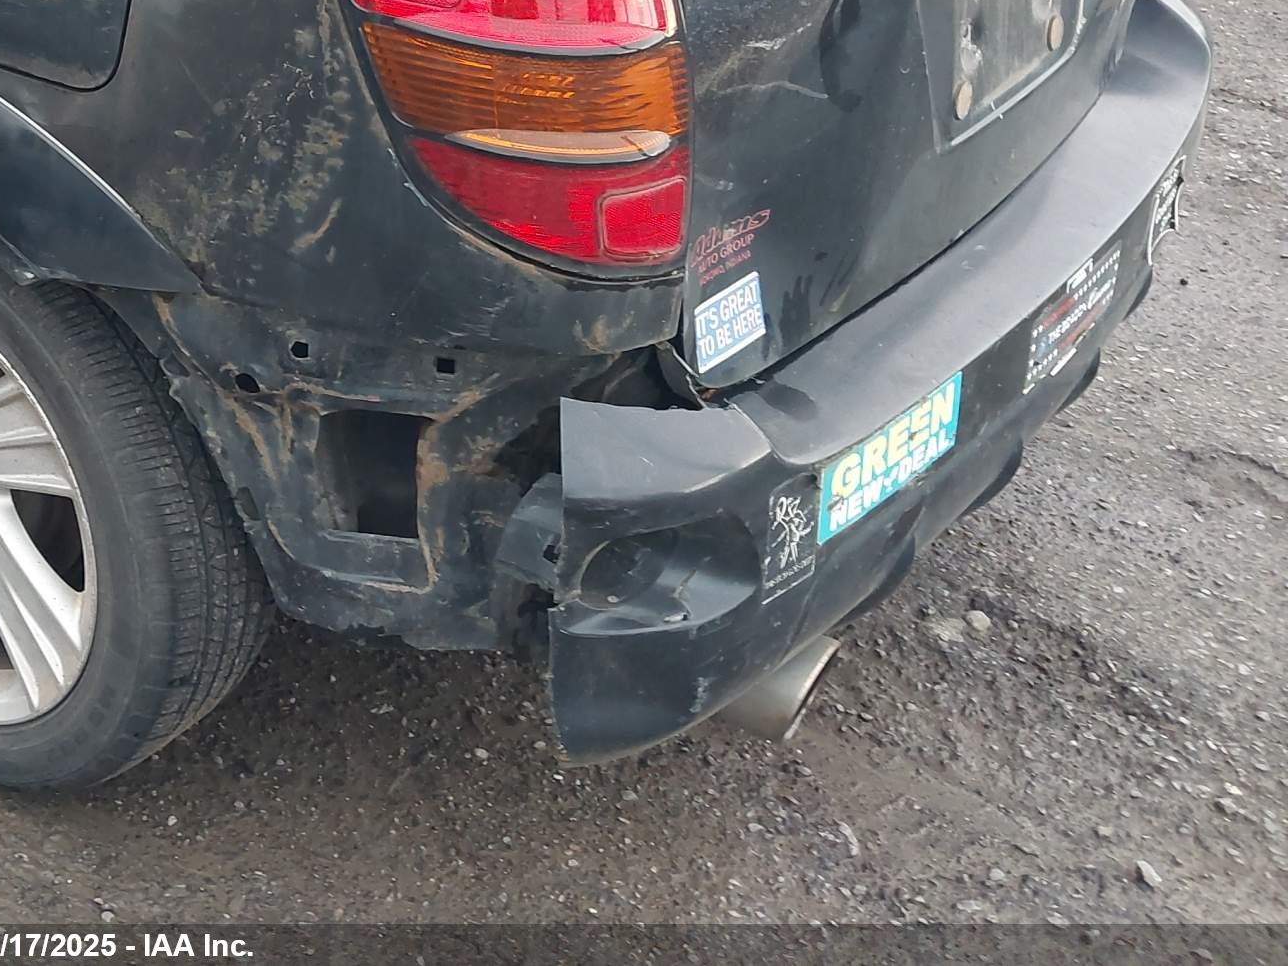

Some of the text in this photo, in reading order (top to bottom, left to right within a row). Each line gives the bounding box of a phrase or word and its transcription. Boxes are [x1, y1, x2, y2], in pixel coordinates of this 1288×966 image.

[719, 233, 754, 259] GROUP
[696, 281, 758, 338] IT'S GREAT
[699, 303, 763, 359] TO BE HERE
[831, 382, 956, 498] GREEN
[829, 476, 886, 532] NEW
[896, 430, 950, 481] DEAL
